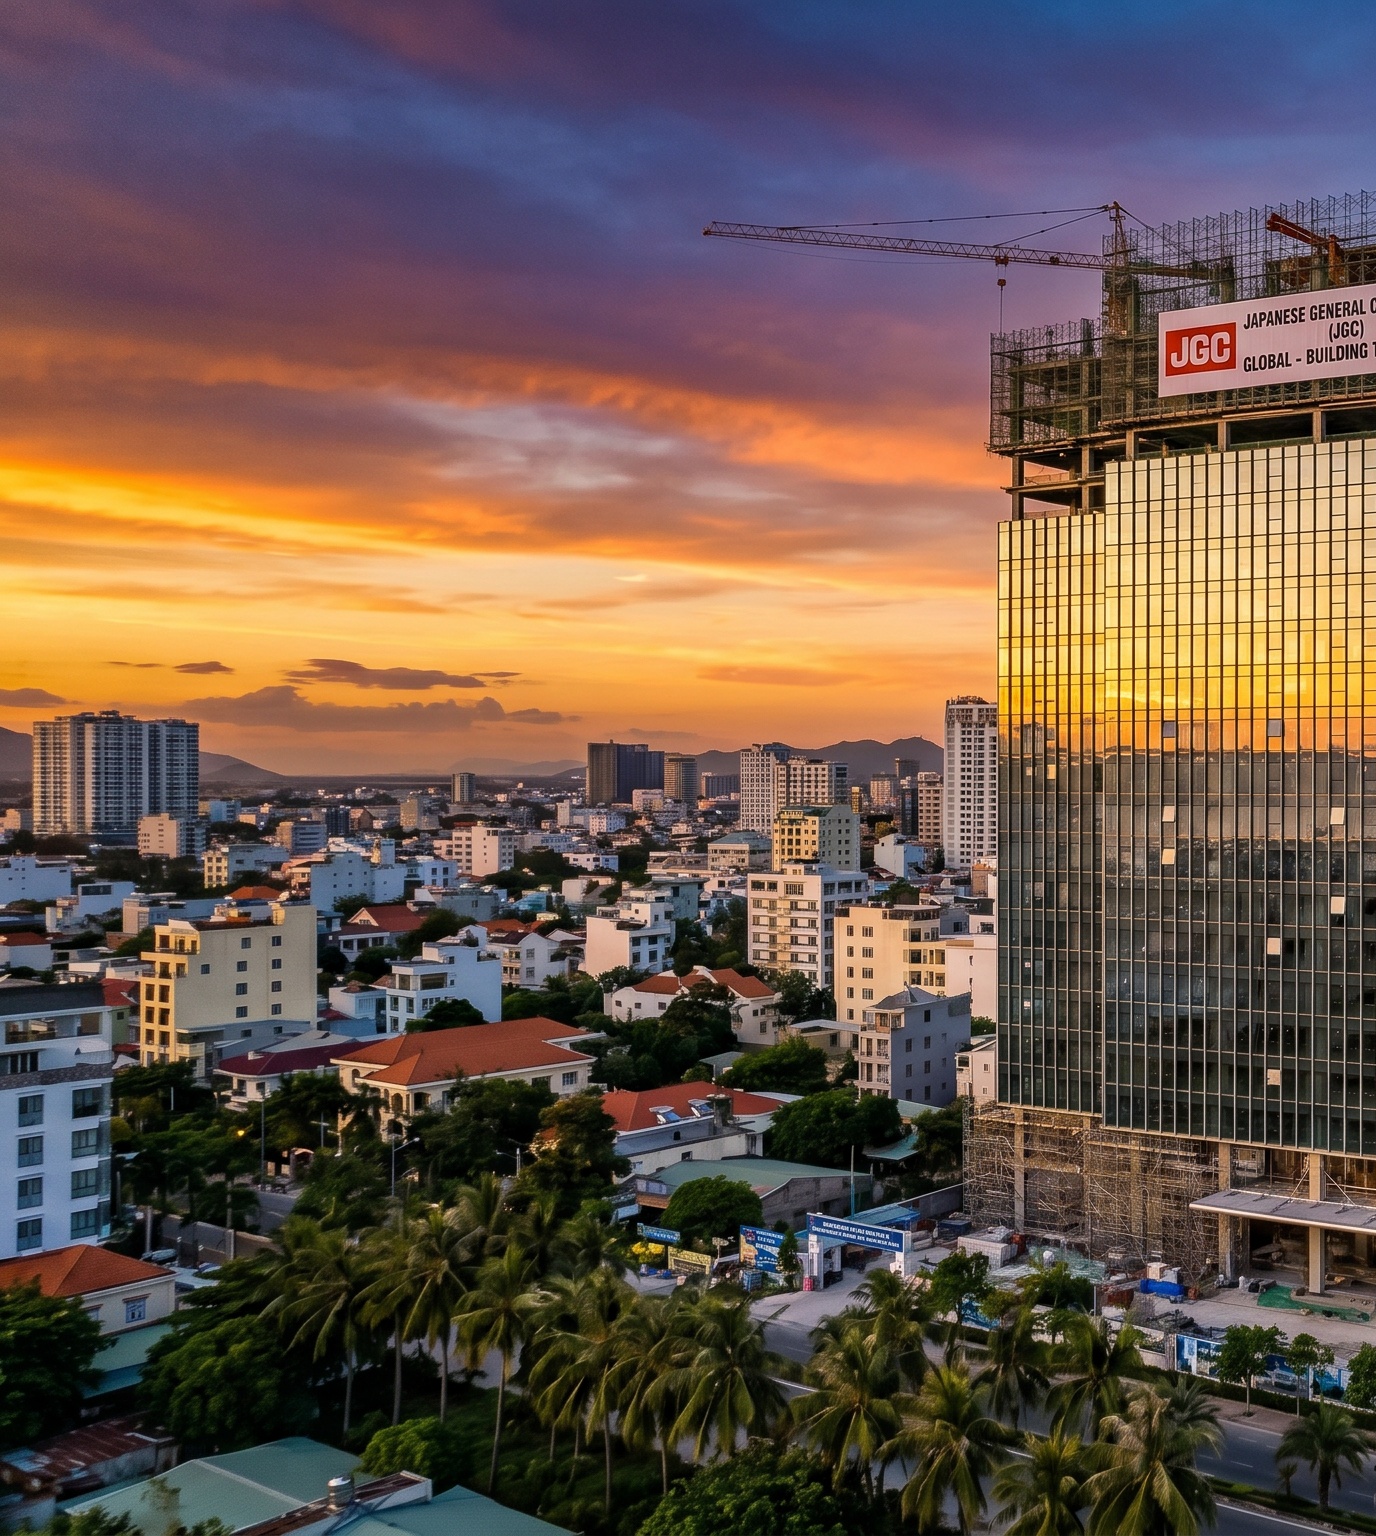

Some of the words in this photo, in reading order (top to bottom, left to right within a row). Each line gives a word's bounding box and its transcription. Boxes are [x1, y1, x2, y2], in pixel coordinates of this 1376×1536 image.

[1243, 306, 1306, 330] JAPANESE
[1309, 299, 1367, 322] GENERAL
[1328, 319, 1365, 343] (JGC)
[1170, 331, 1231, 368] JGC
[1243, 351, 1292, 373] GLOBAL
[1306, 342, 1368, 365] BUILDING
